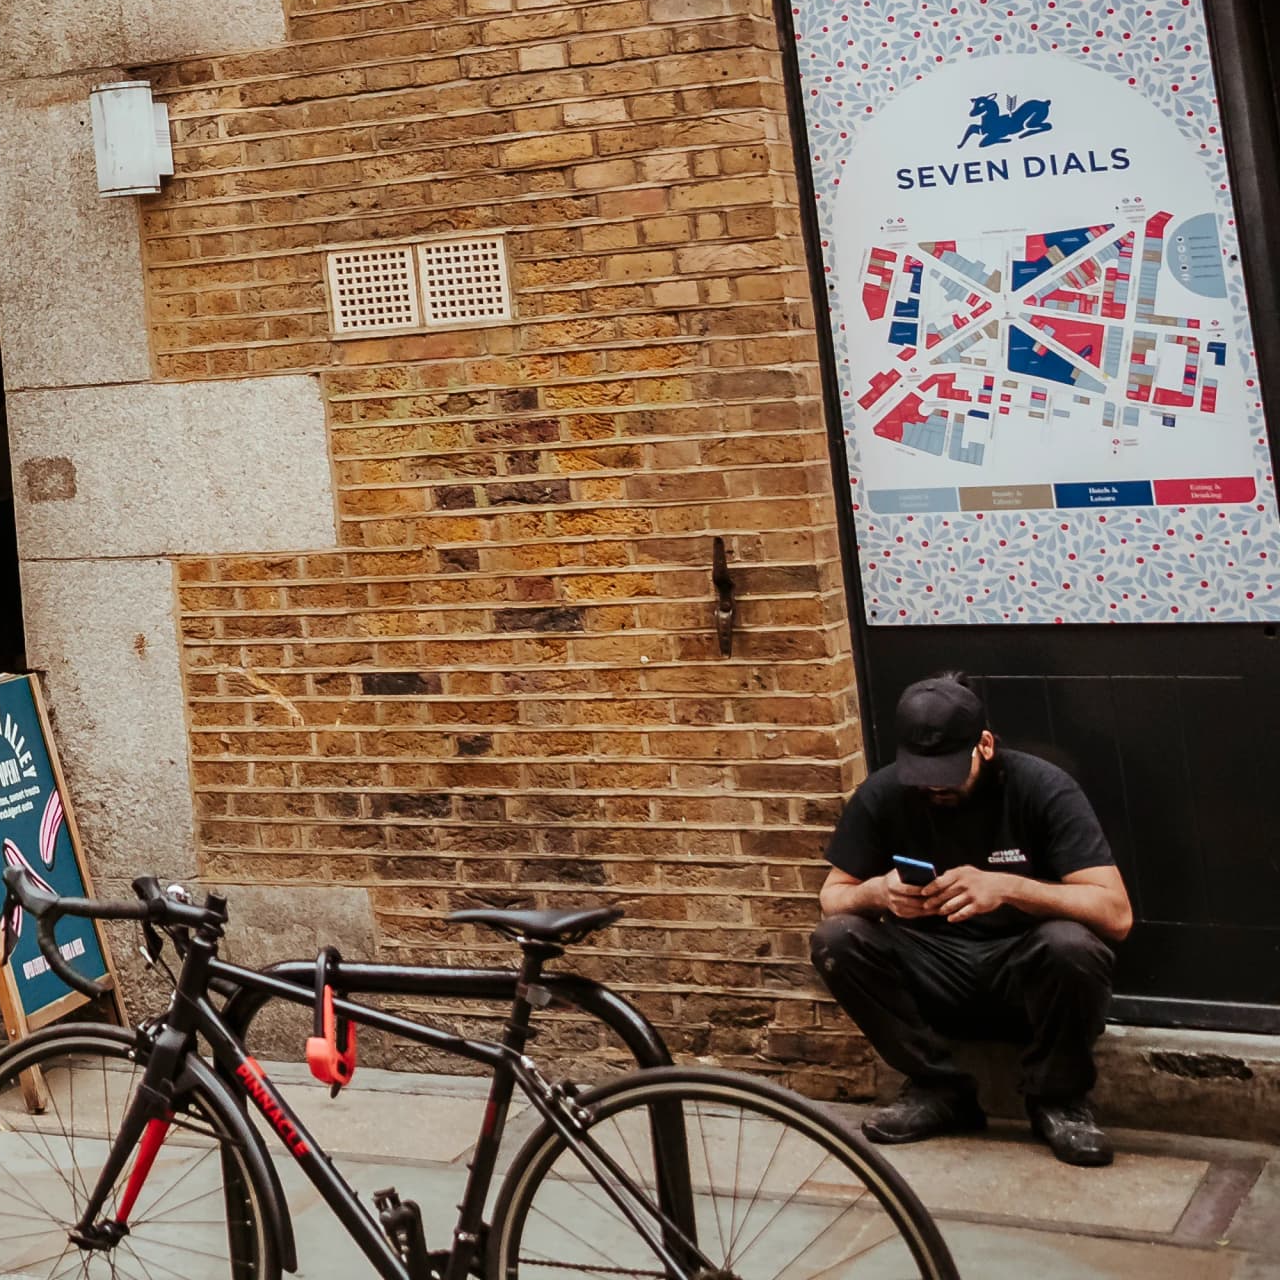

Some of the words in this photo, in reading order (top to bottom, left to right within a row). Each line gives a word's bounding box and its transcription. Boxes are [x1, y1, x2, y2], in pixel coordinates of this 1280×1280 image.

[896, 158, 1009, 189] SEVEN
[1023, 148, 1130, 178] DIALS
[4, 713, 37, 778] ALLEY
[236, 1063, 311, 1157] PINNACLE
